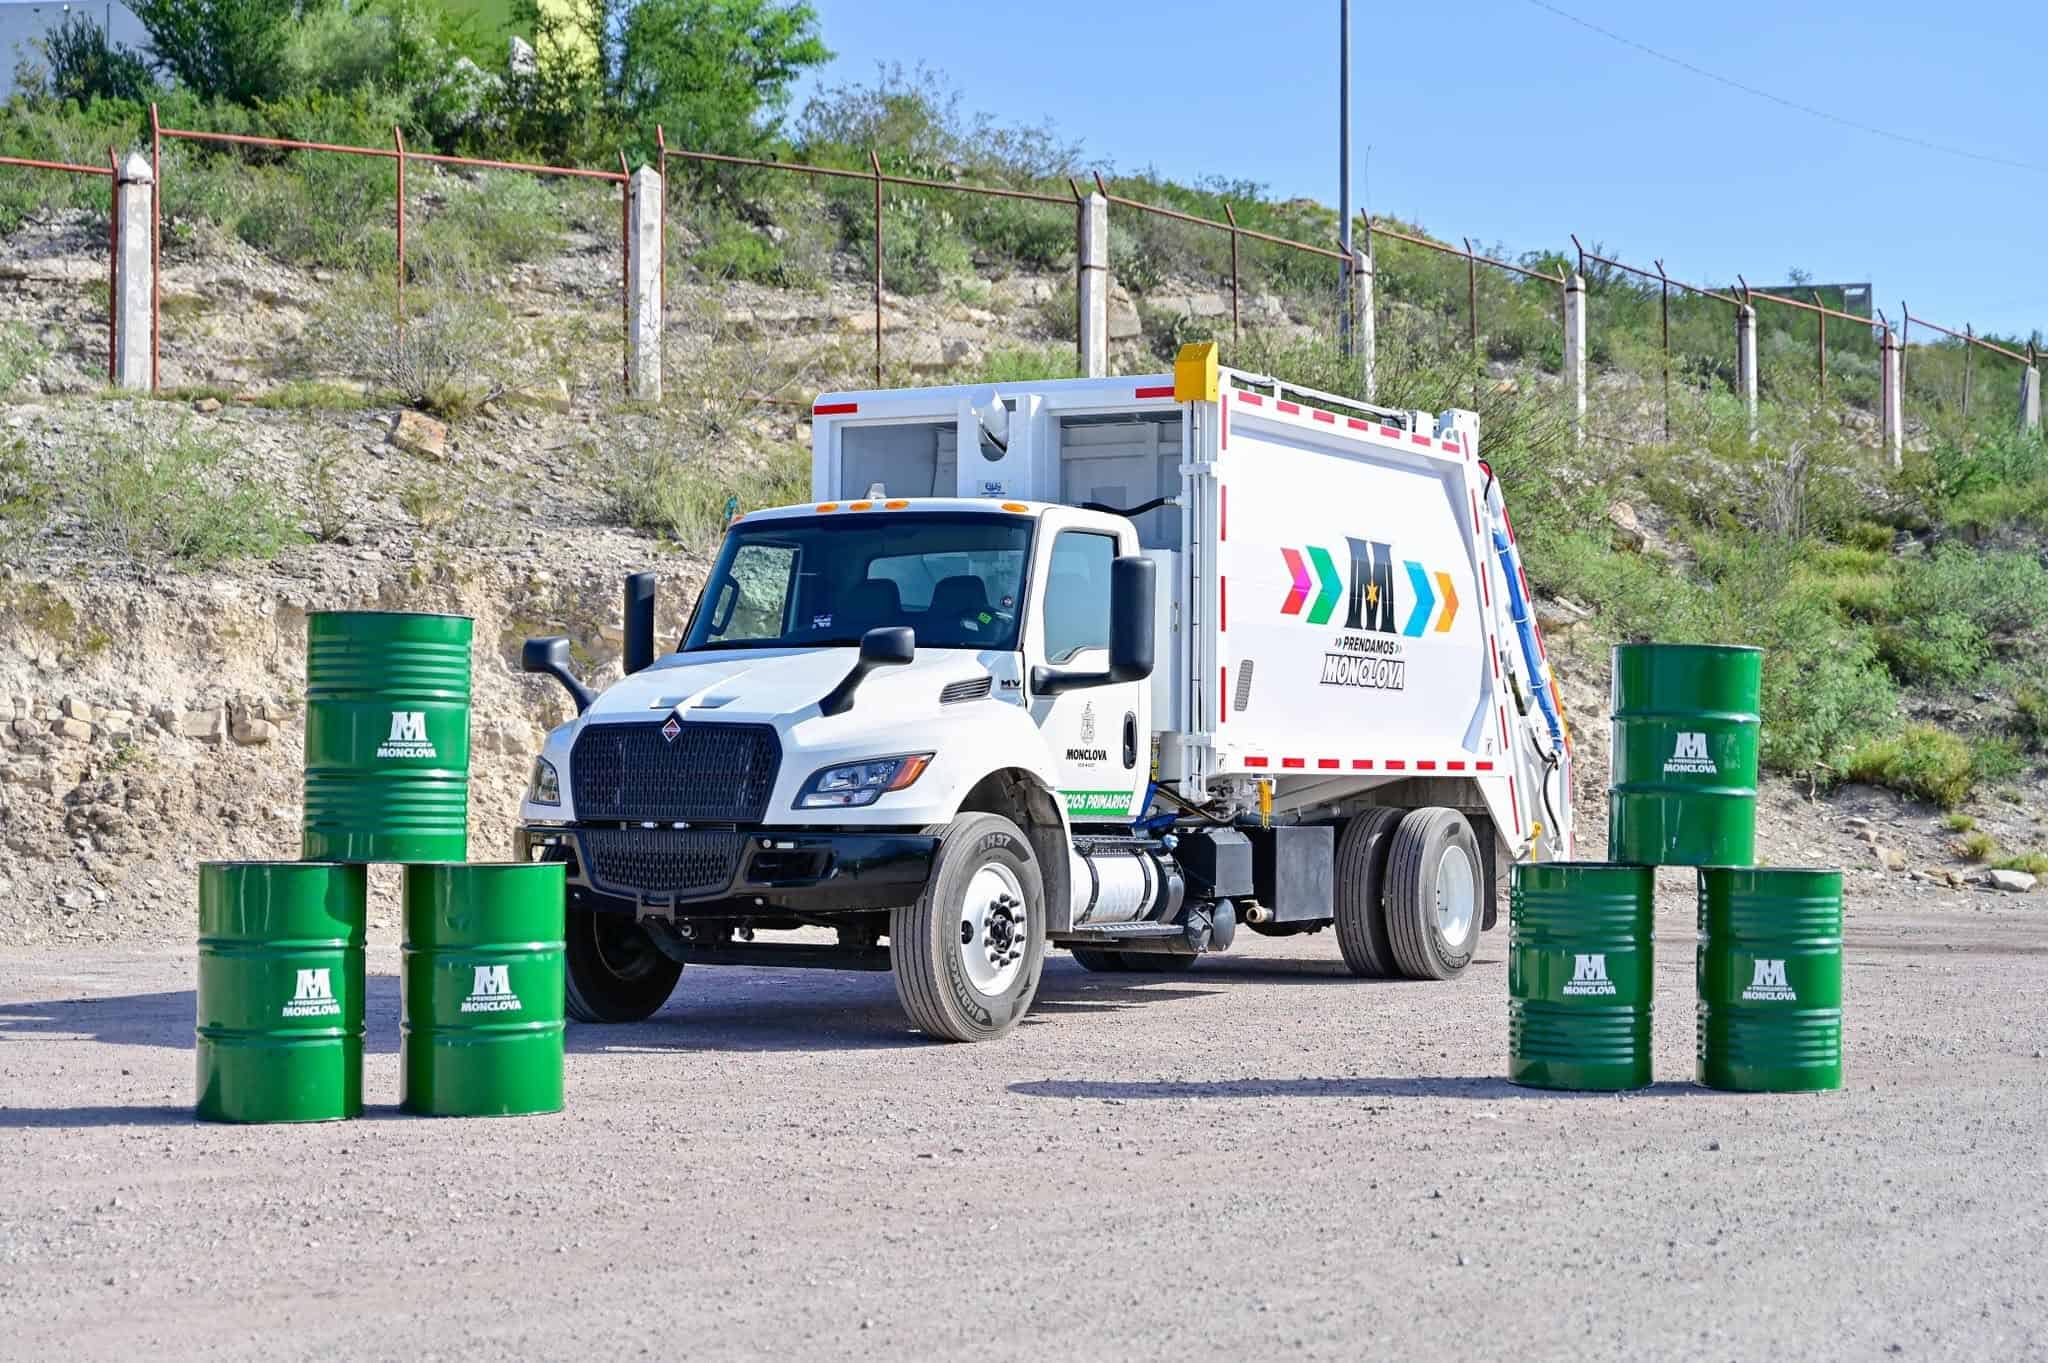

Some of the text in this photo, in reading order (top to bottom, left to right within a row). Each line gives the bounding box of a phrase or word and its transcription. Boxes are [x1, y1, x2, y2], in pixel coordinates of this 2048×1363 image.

[1343, 636, 1394, 654] PRENDAMOS
[1320, 653, 1405, 690] MONCLOVA
[1000, 679, 1021, 688] MV
[376, 747, 437, 758] MONCLOVA
[1066, 749, 1107, 761] MONCLOVA
[1663, 763, 1717, 775] MONCLOVA
[1562, 985, 1617, 995] MONCLOVA
[1742, 991, 1797, 1001] MONCLOVA
[282, 1004, 341, 1017] MONCLOVA
[461, 999, 522, 1013] MONCLOVA
